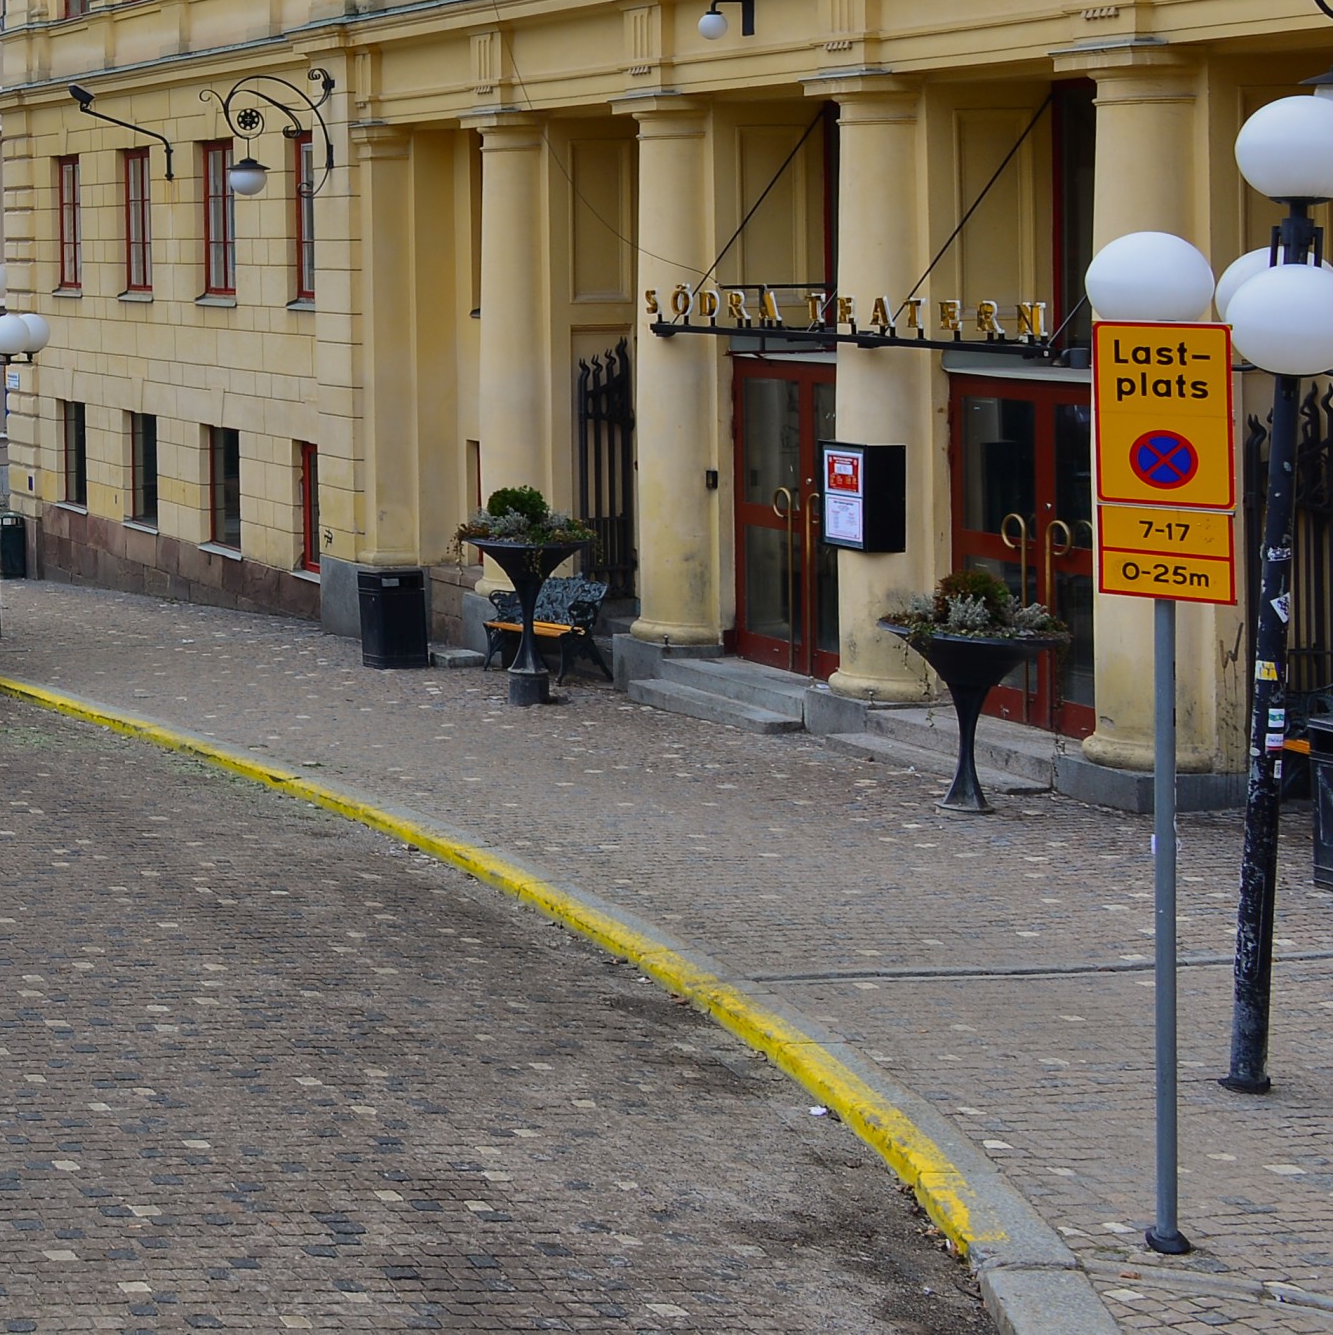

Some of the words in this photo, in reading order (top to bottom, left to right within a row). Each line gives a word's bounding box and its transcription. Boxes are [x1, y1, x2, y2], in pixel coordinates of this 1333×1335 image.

[644, 282, 781, 321] SÖDRA
[805, 292, 1049, 338] TEATERN
[1113, 339, 1211, 367] Last-
[1116, 372, 1210, 402] plats
[1138, 520, 1190, 542] 7-17
[1121, 561, 1210, 588] 0-25m
